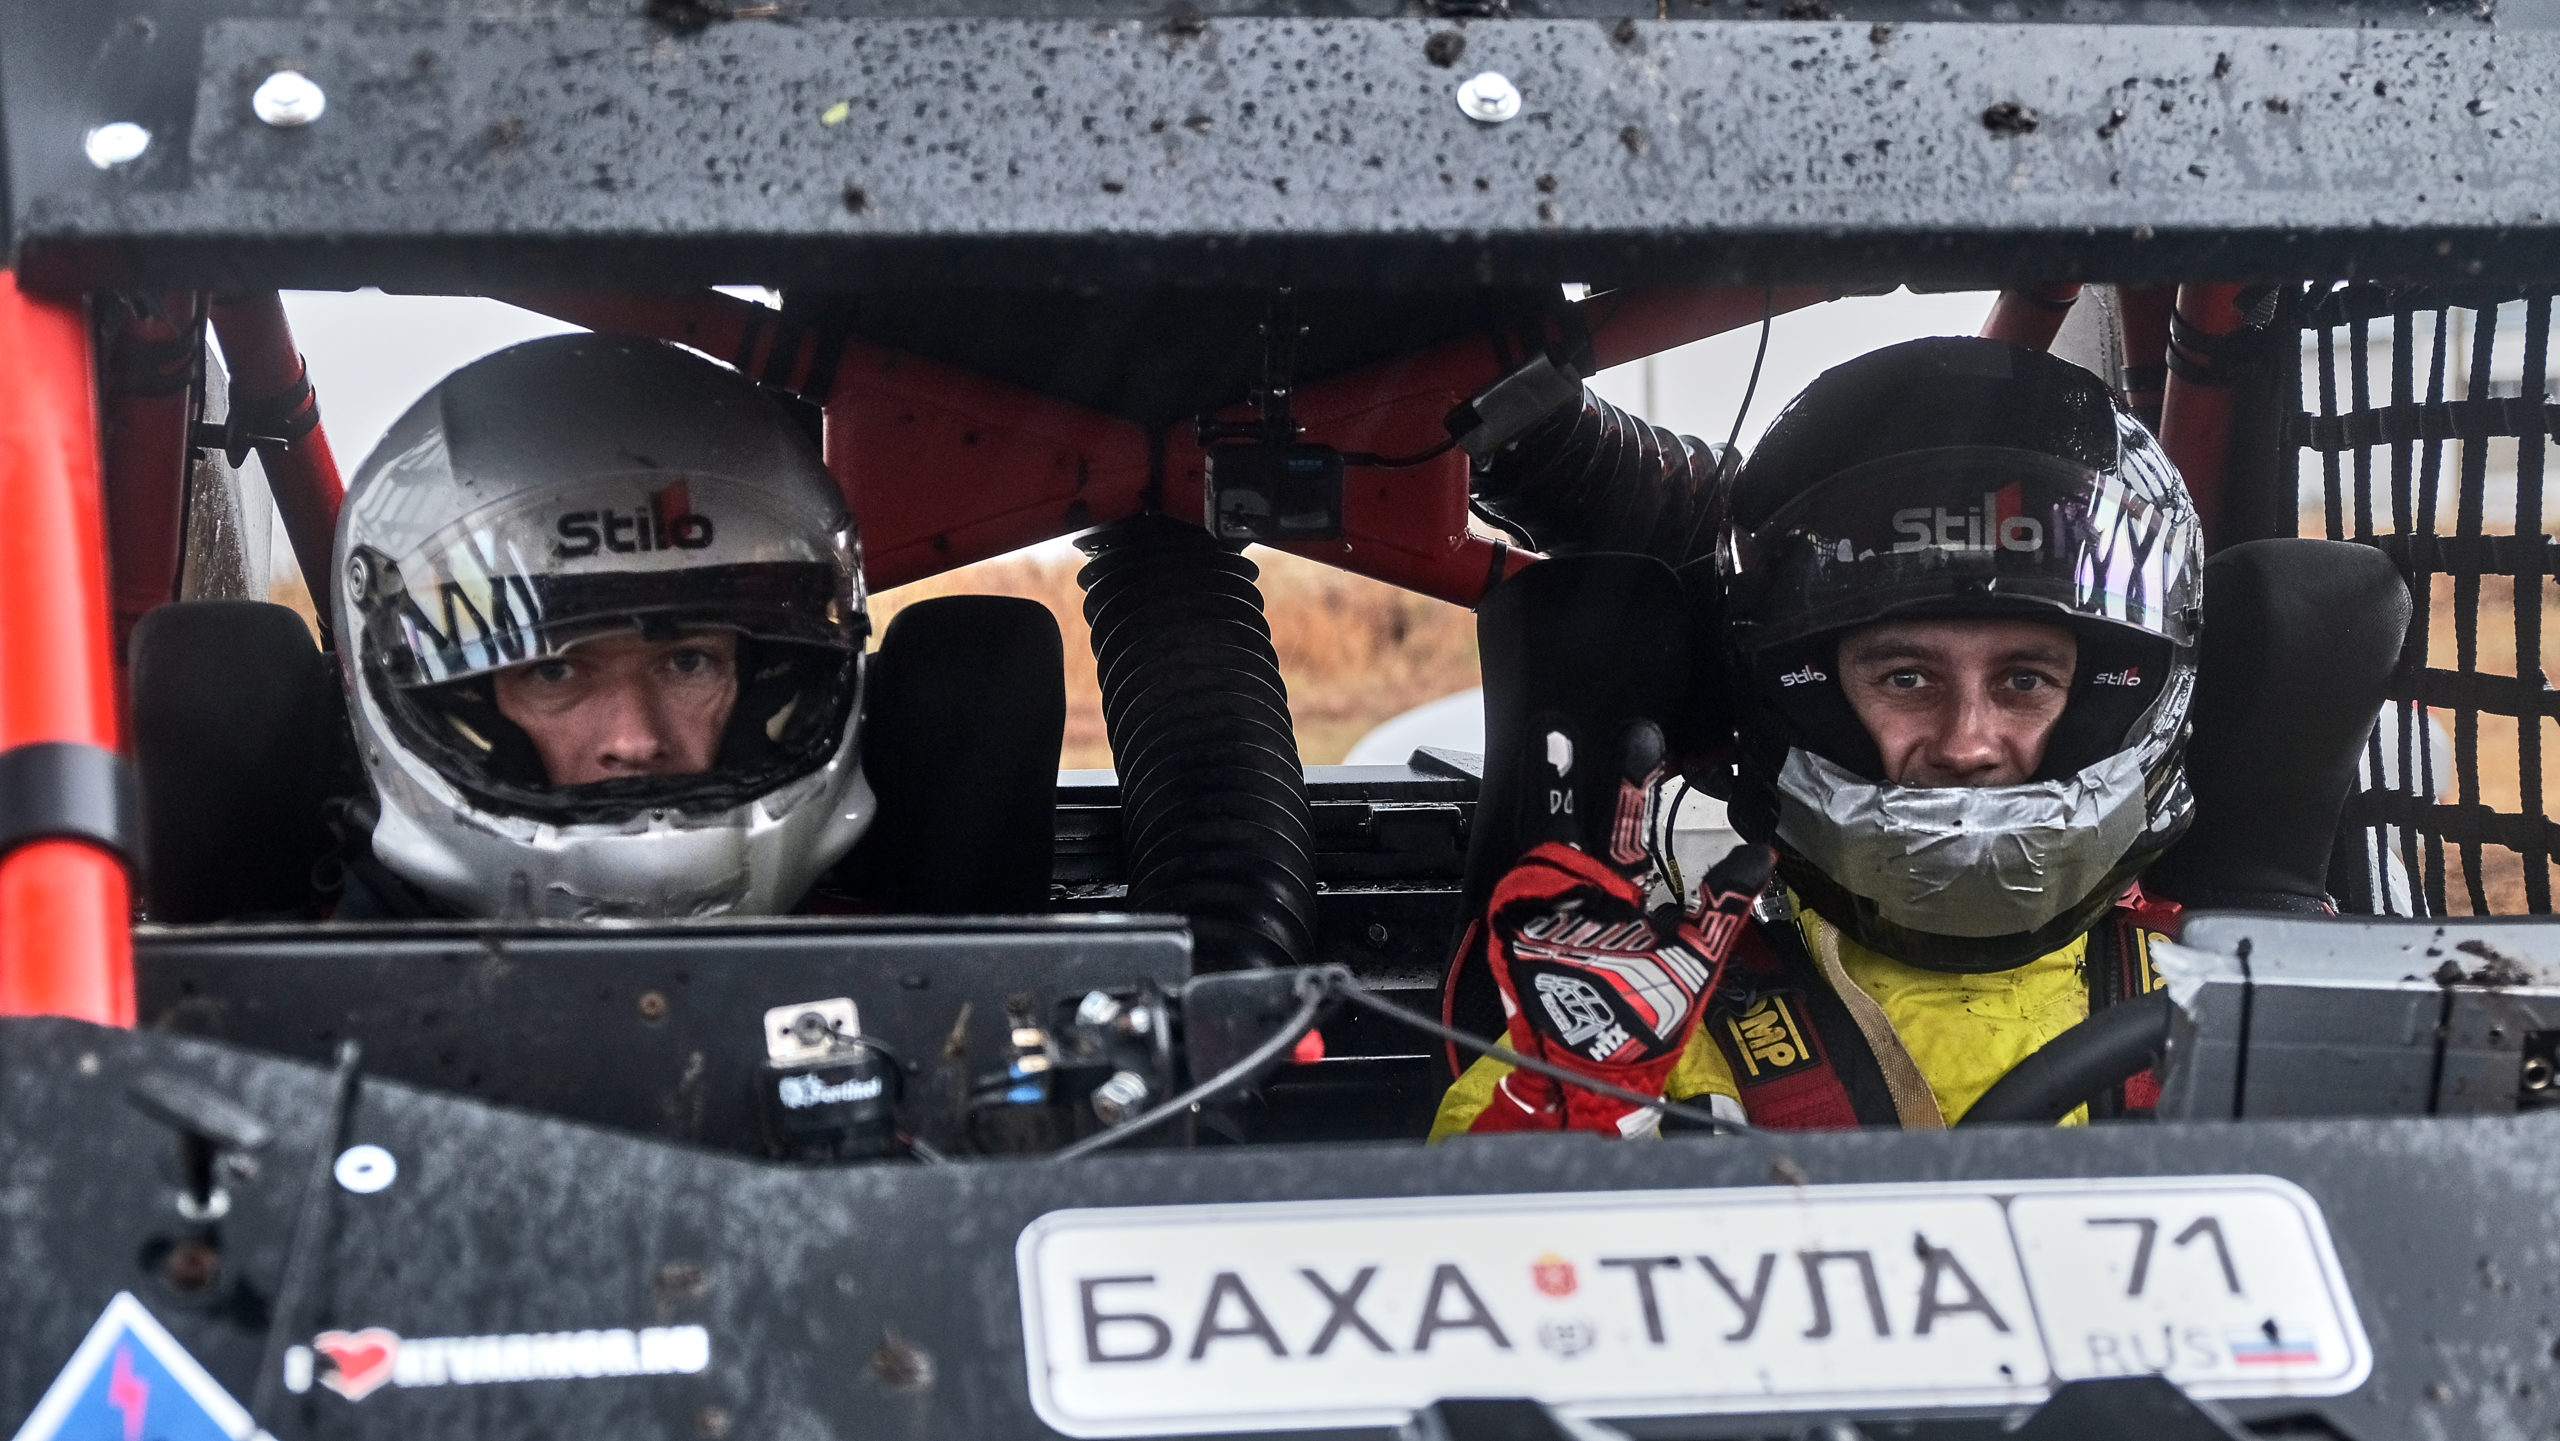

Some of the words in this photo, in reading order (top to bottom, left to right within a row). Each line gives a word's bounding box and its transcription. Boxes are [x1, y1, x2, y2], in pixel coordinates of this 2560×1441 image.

[2085, 1216, 2242, 1298] 71
[1078, 1262, 1511, 1363] БАХА
[1598, 1245, 2011, 1343] ТУЛА
[2088, 1327, 2220, 1375] RUS
